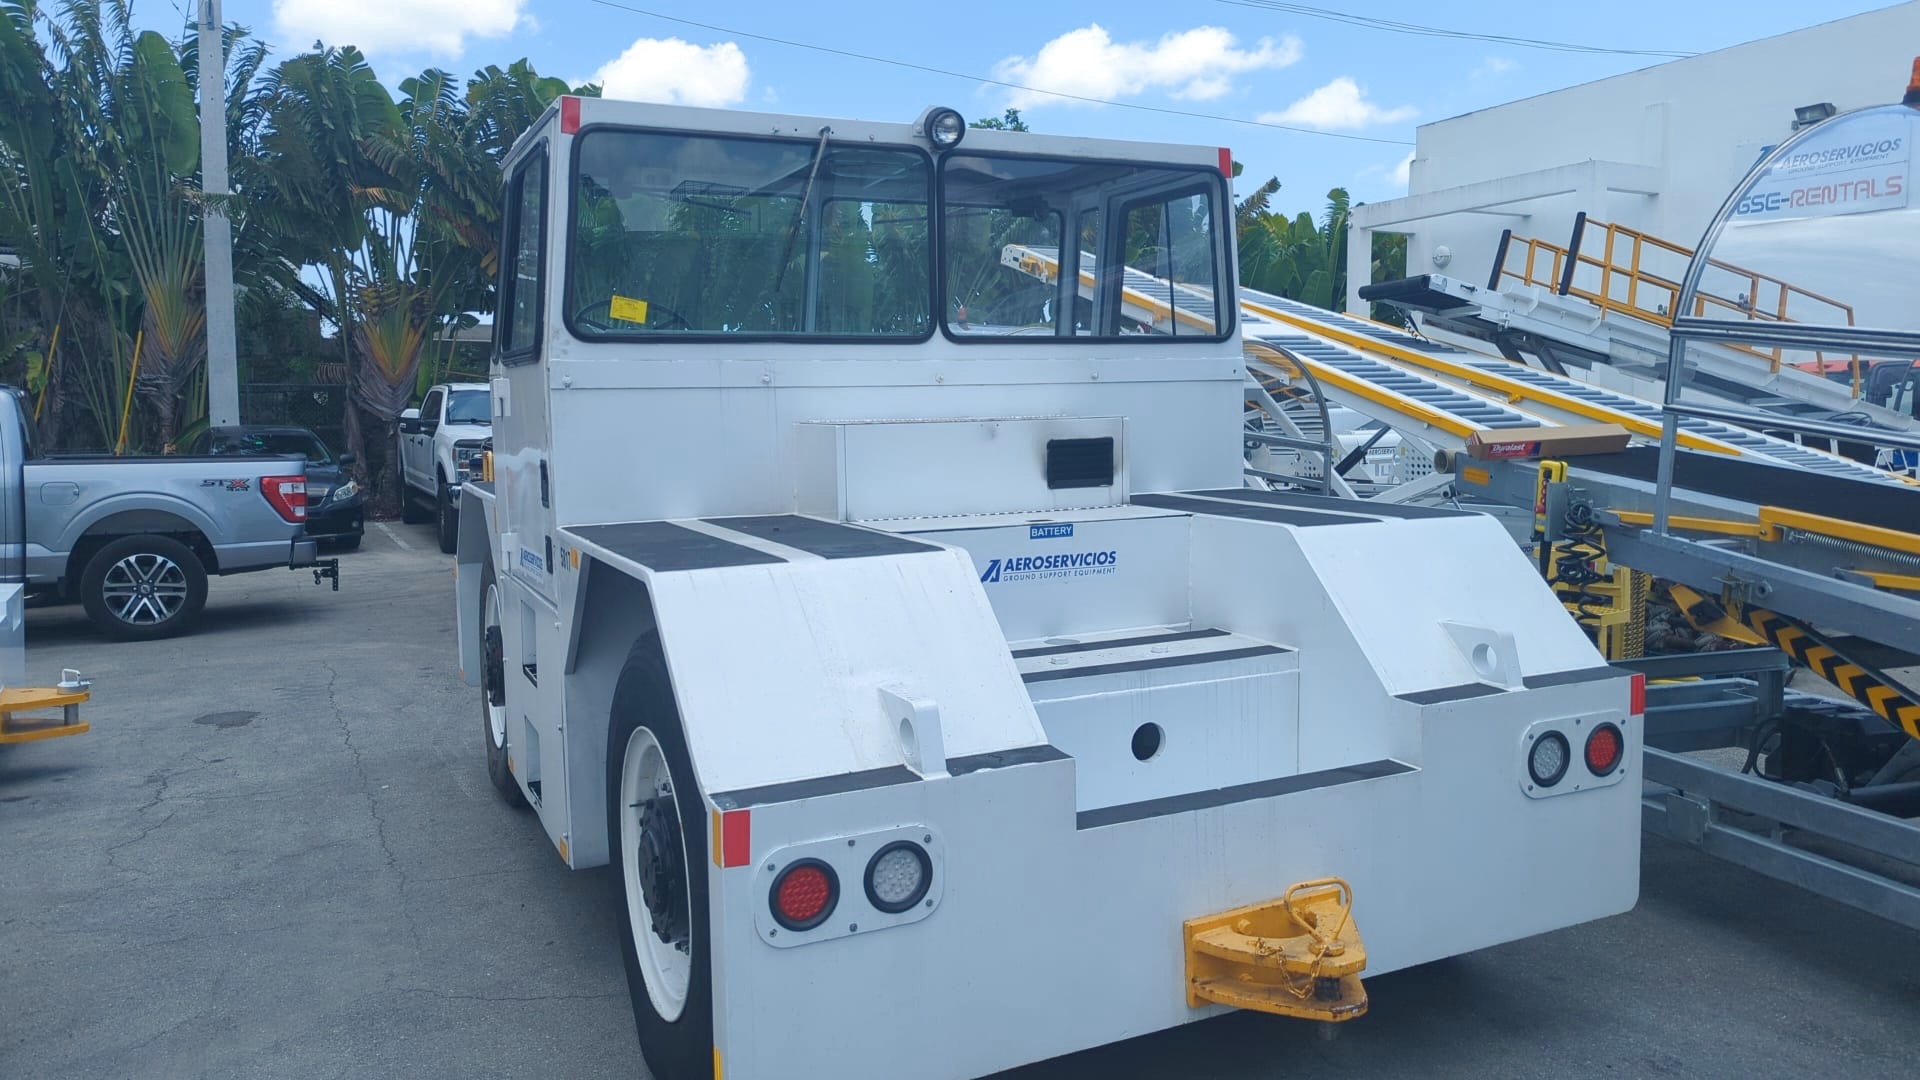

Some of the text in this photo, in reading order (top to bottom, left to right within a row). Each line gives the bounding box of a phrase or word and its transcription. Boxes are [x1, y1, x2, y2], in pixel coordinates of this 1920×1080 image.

[1780, 138, 1902, 169] AEROSERVICIOS
[1736, 175, 1903, 215] GSE-RENTALS
[1492, 443, 1526, 453] Duralast
[1031, 526, 1073, 537] BATTERY
[1003, 551, 1117, 572] AEROSERVICIOS
[1003, 567, 1116, 582] GROUND SUPPORT EQUIPMENT
